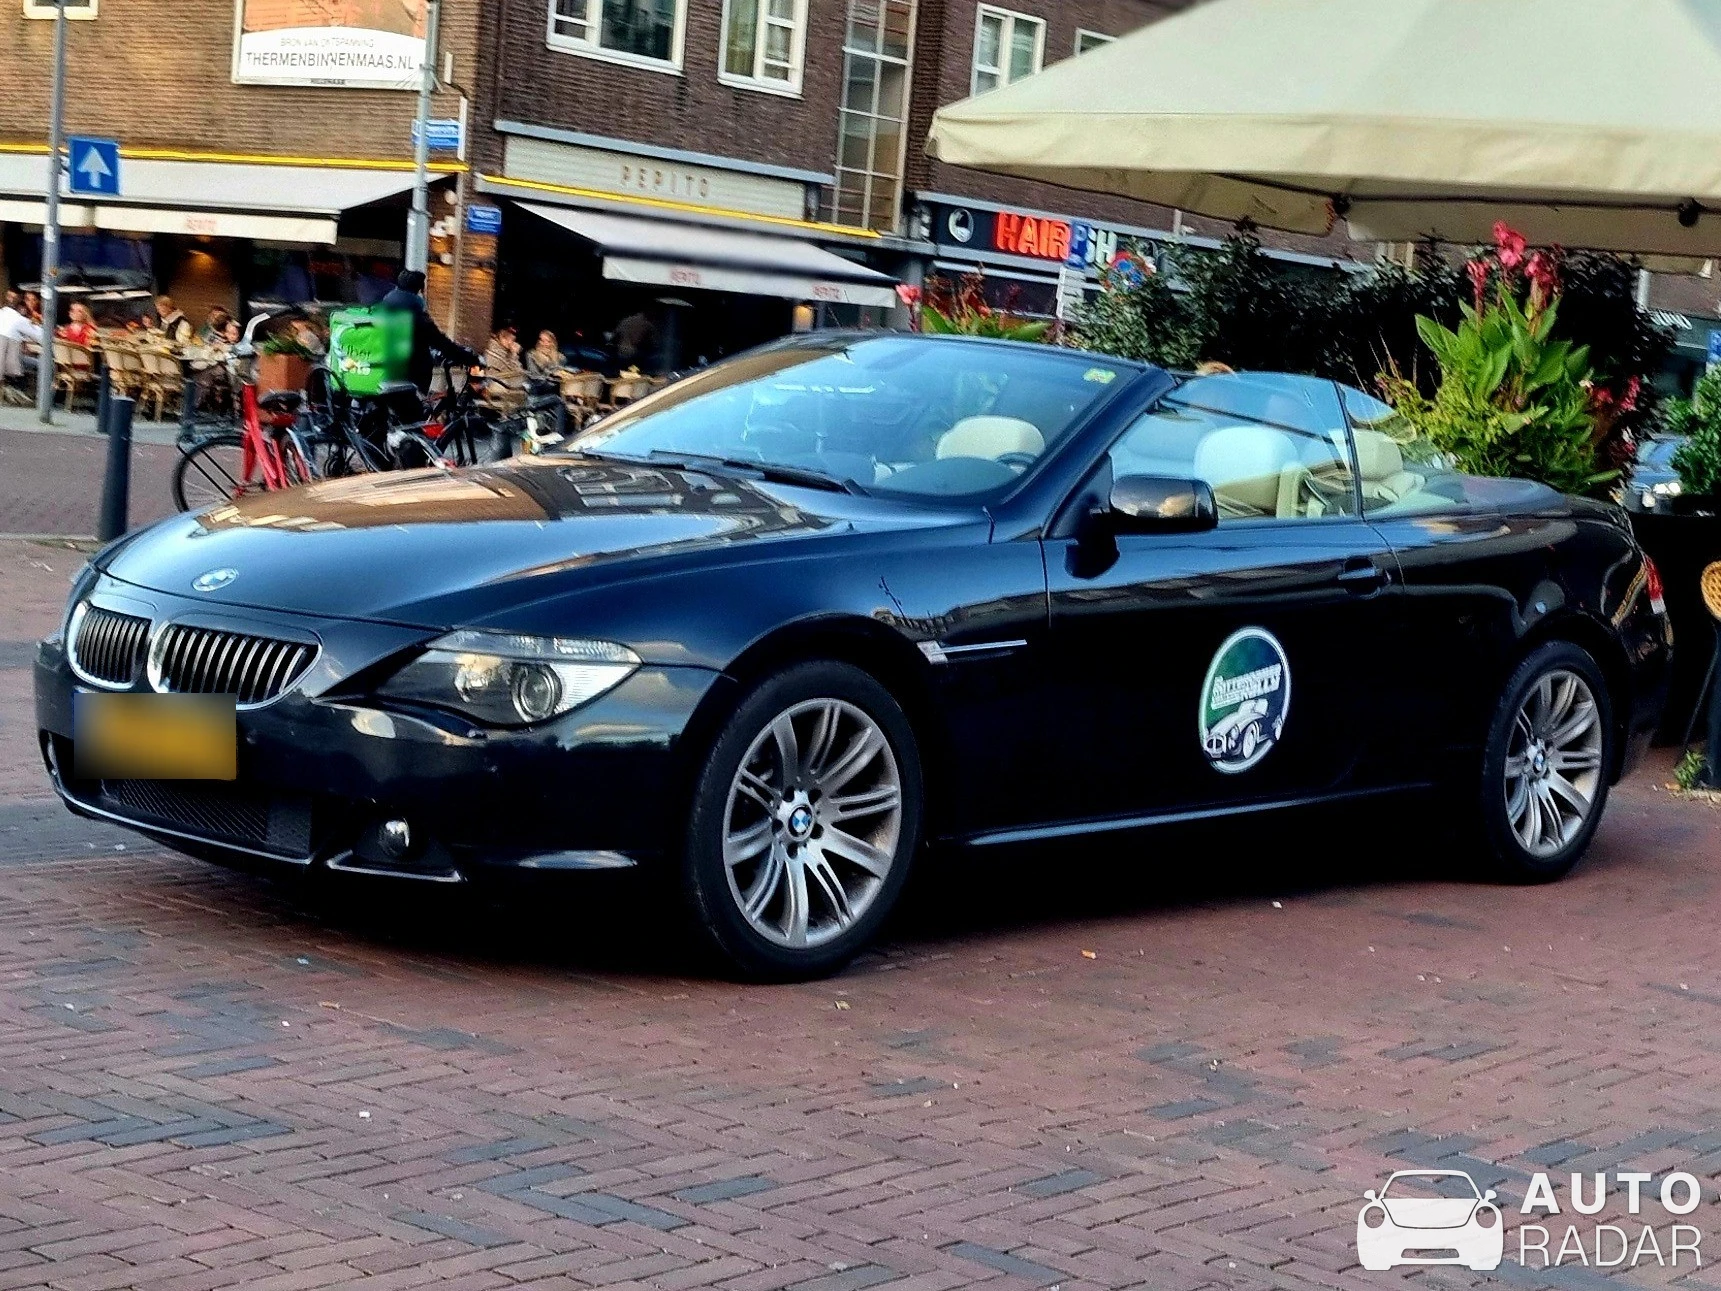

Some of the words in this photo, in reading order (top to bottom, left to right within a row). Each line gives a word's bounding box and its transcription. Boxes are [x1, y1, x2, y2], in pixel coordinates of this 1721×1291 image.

[246, 51, 415, 70] THERMENBINNENMAAS.NL
[622, 165, 708, 198] PEPITO
[997, 211, 1071, 260] HAIR
